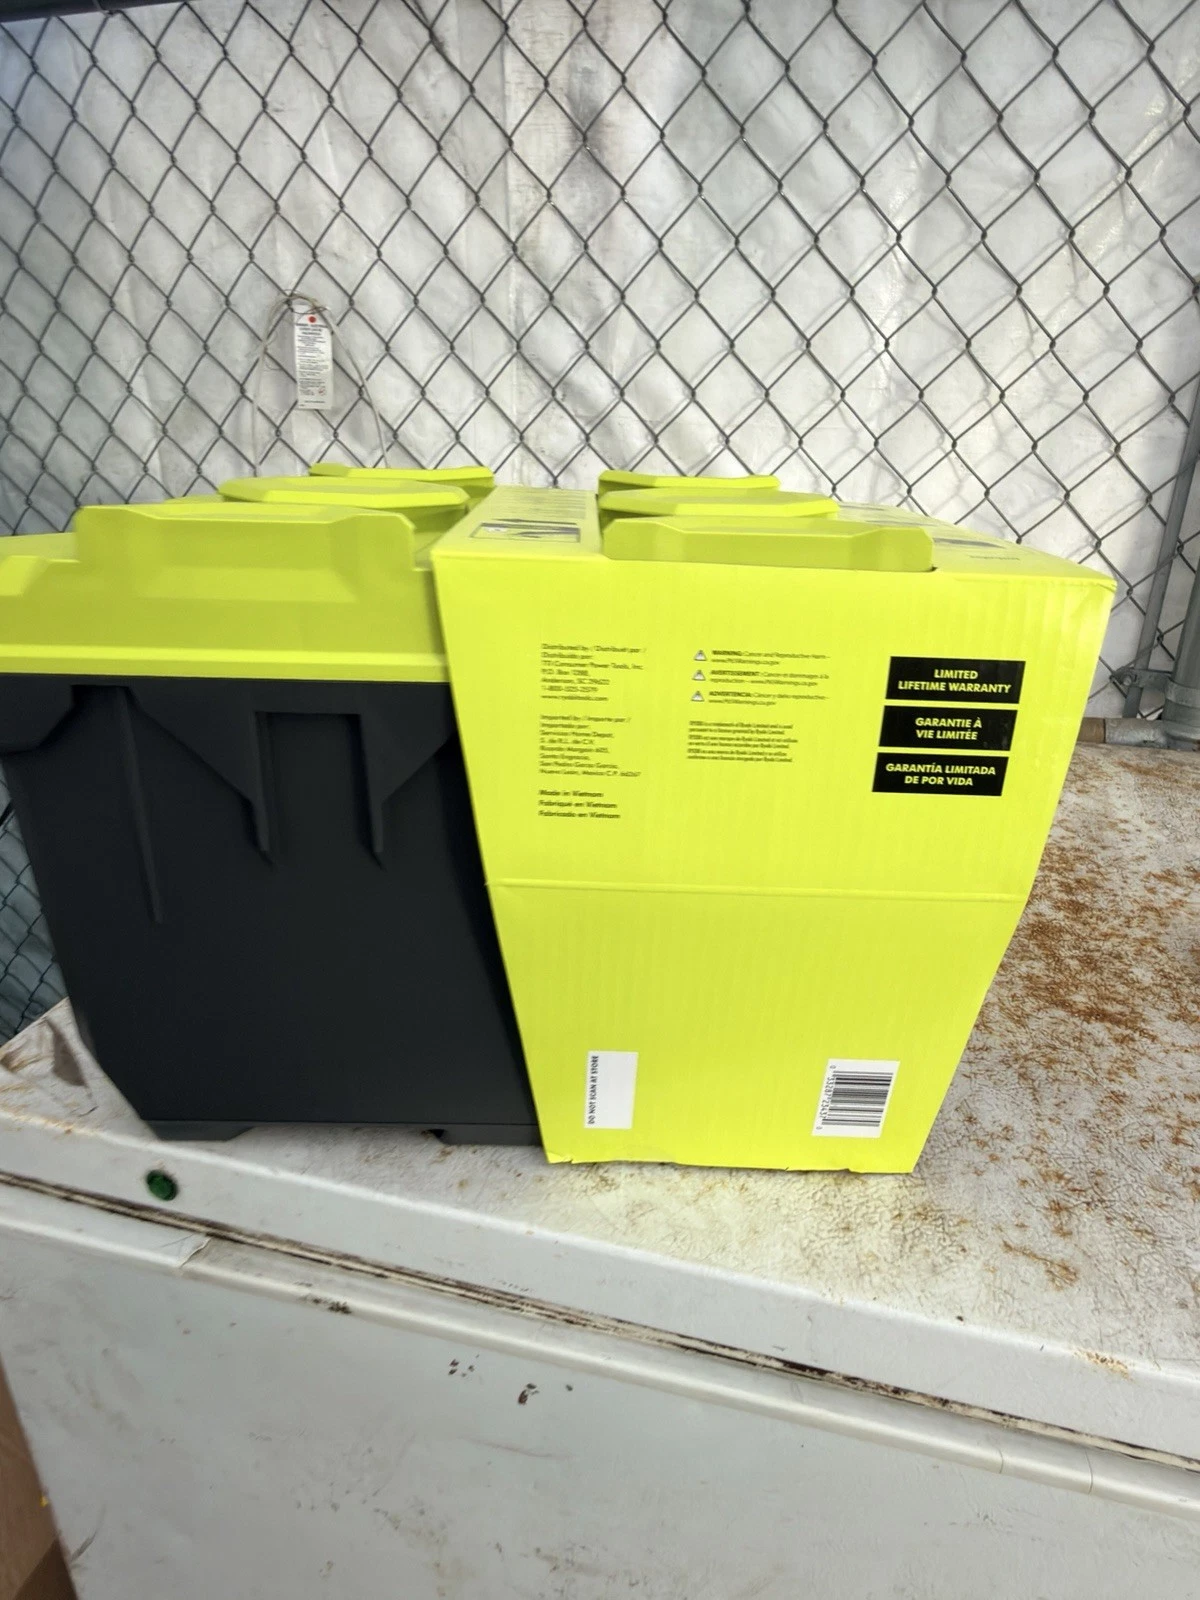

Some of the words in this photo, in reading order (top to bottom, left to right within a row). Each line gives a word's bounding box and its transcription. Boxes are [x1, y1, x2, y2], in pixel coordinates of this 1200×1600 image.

[934, 669, 978, 679] LIMITED
[898, 681, 946, 691] LIFETIME
[949, 683, 1011, 693] WARRANTY
[915, 717, 971, 727] GARANTIE
[973, 717, 982, 728] À
[916, 730, 934, 738] VIE
[936, 729, 978, 740] LIMITÉE
[886, 763, 942, 773] GARANTÍA
[945, 764, 996, 775] LIMITADA
[905, 776, 919, 784] DE
[947, 777, 973, 785] VIDA
[572, 790, 604, 798] Vietnam
[588, 1115, 595, 1124] DO
